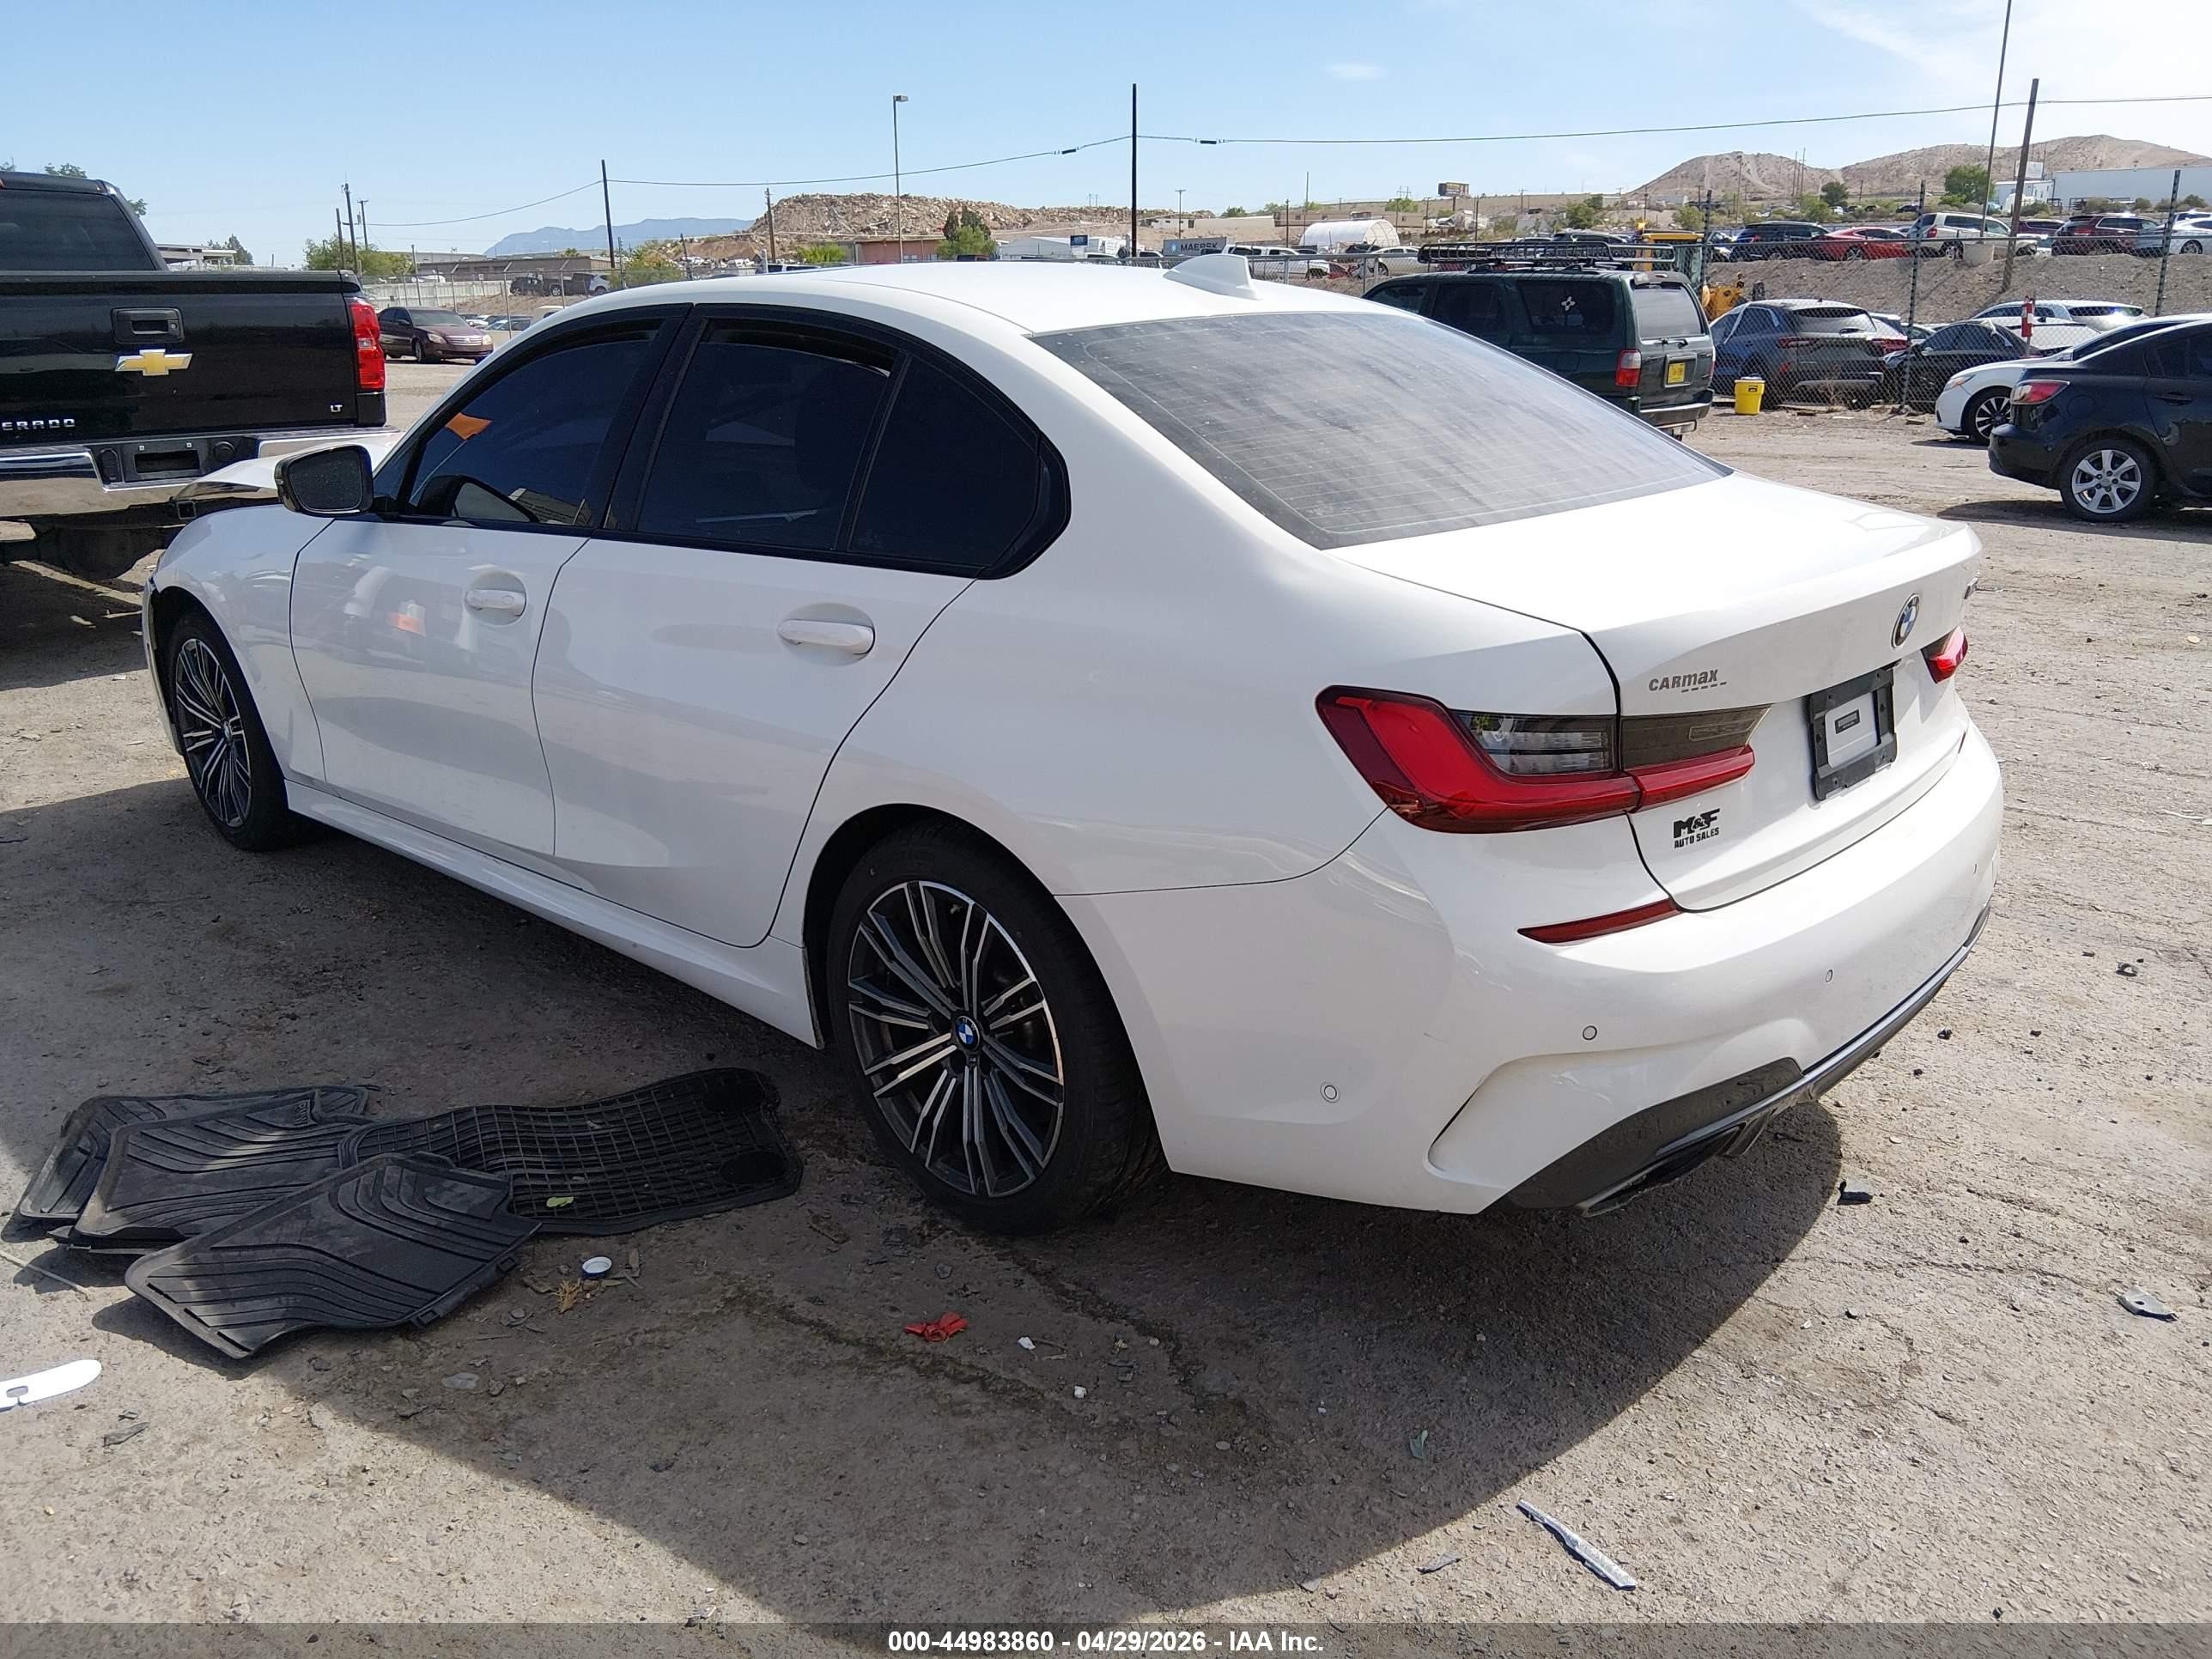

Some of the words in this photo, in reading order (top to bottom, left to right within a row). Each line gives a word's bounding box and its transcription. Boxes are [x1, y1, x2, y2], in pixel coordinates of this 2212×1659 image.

[1674, 808, 1720, 838] M&F
[1674, 835, 1694, 848] AUTO
[1696, 827, 1719, 842] SALES
